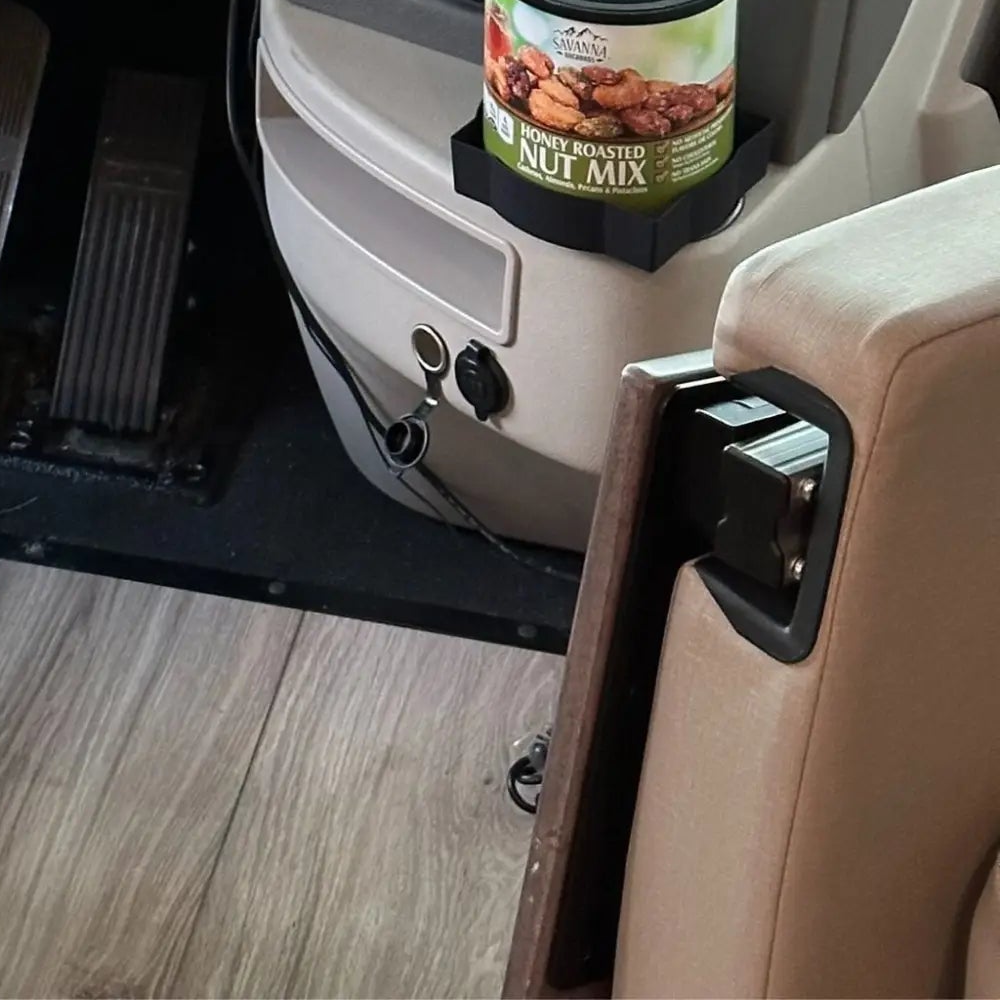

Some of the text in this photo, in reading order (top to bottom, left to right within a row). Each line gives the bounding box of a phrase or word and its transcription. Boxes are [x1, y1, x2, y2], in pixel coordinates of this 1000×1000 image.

[552, 36, 607, 59] SAVANNA
[520, 121, 569, 152] HONEY
[573, 141, 646, 160] ROASTED
[520, 136, 578, 180] NUT
[586, 158, 647, 186] MIX
